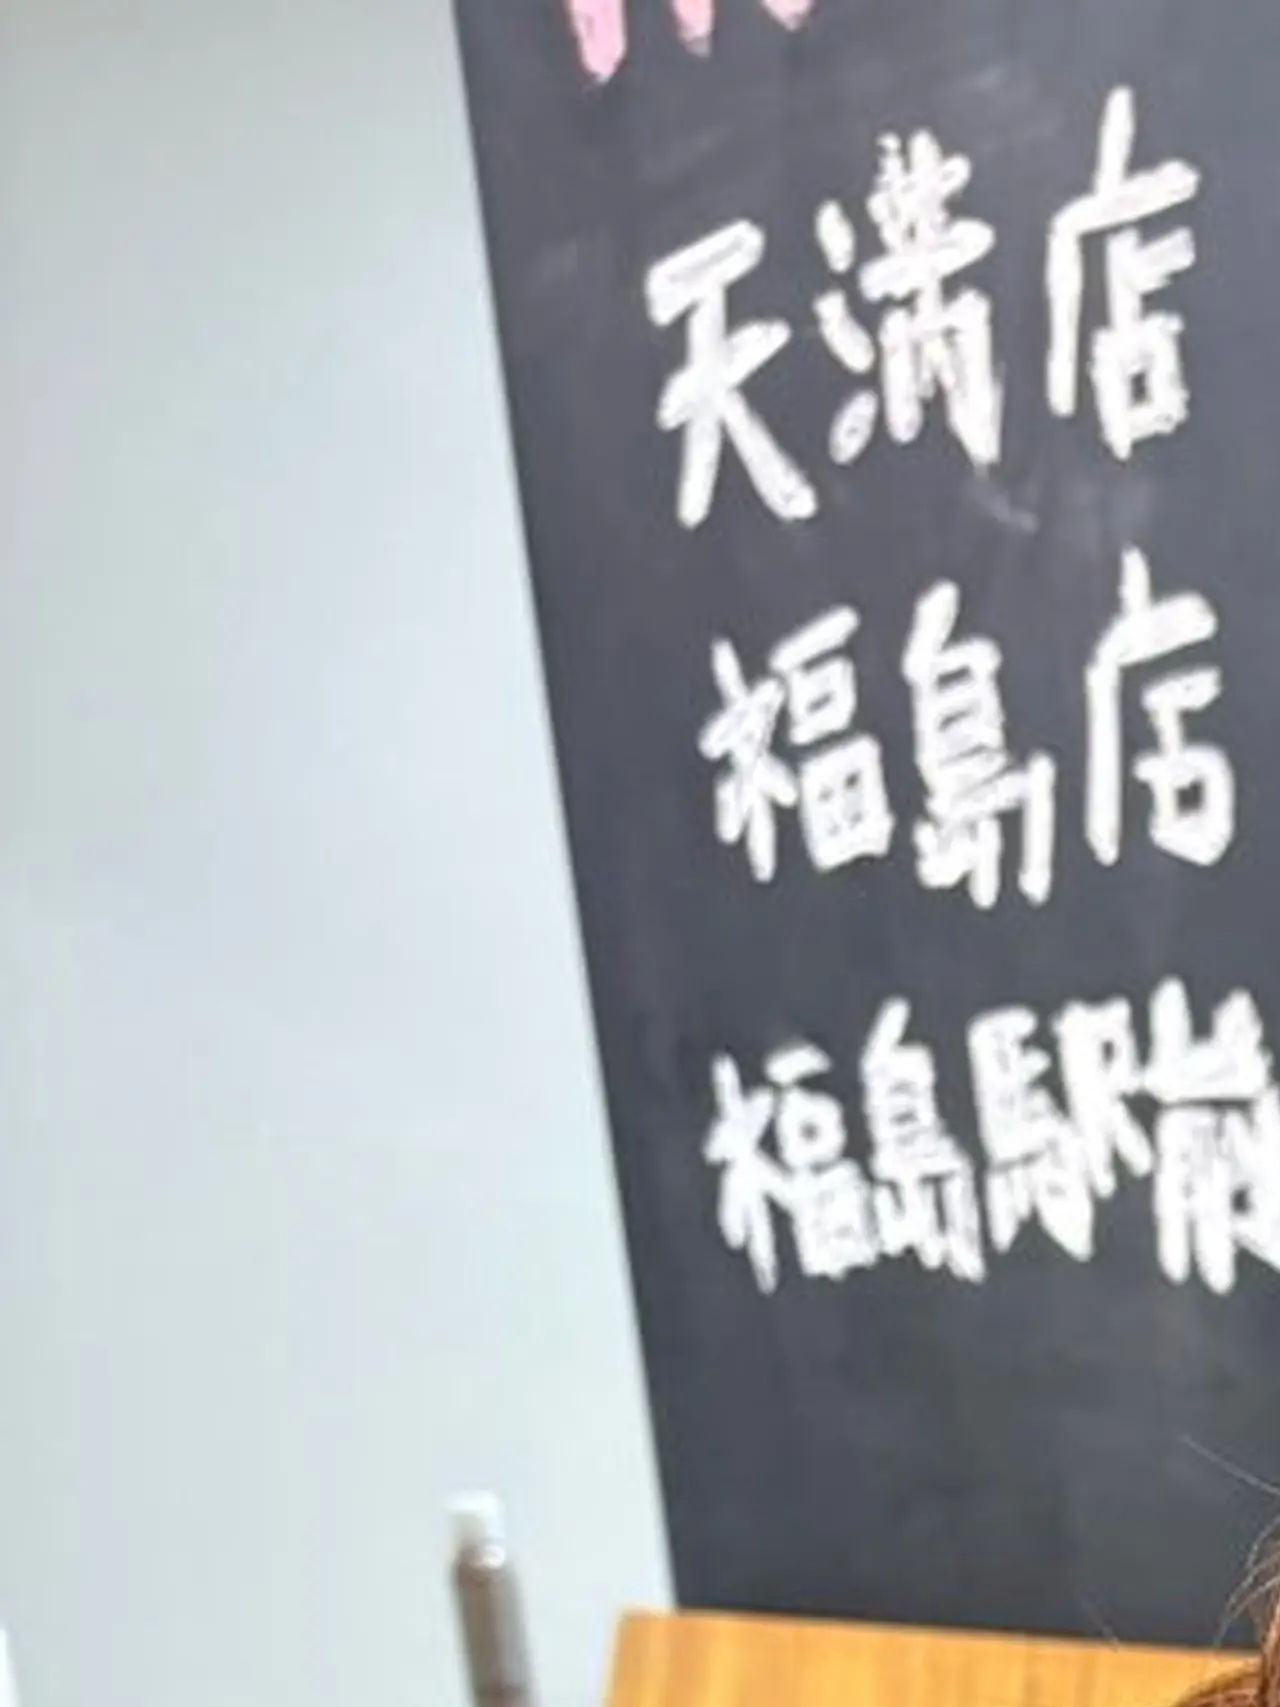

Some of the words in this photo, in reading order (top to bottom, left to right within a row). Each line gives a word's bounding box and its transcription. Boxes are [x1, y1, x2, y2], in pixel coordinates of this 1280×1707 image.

[644, 85, 1201, 528] 天満店
[699, 545, 1235, 908] 福島店
